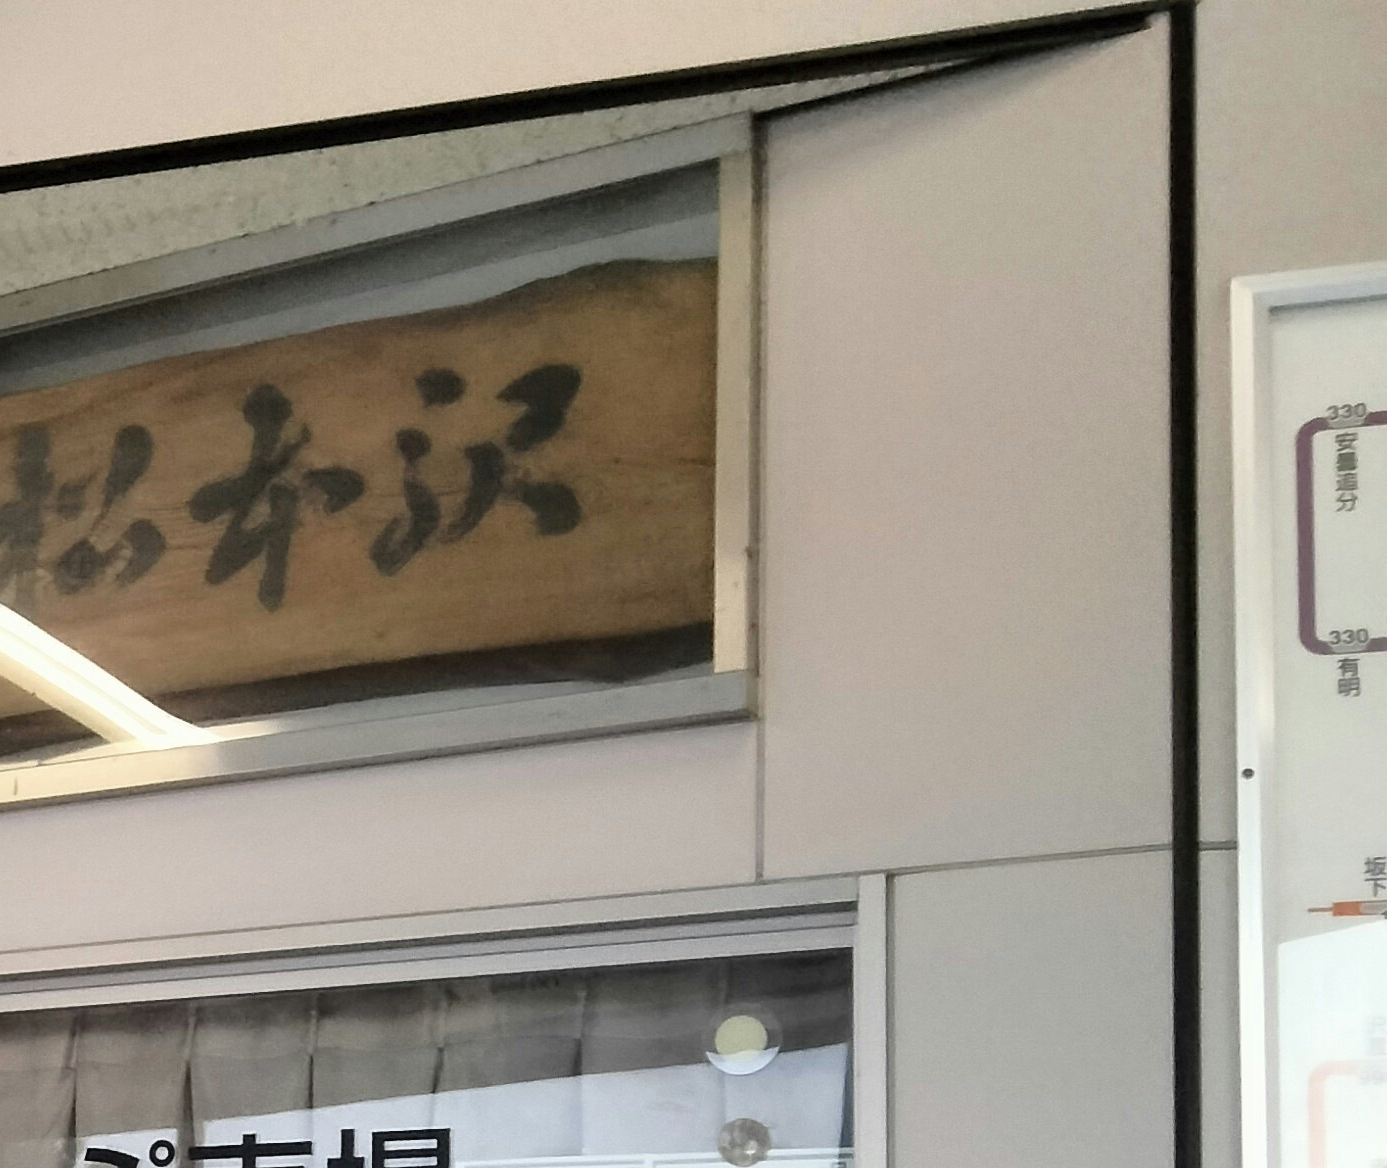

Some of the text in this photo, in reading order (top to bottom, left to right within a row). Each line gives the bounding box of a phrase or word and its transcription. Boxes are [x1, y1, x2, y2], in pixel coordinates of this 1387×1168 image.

[1326, 403, 1367, 420] 330
[1329, 628, 1369, 645] 330
[1337, 657, 1360, 697] 有明
